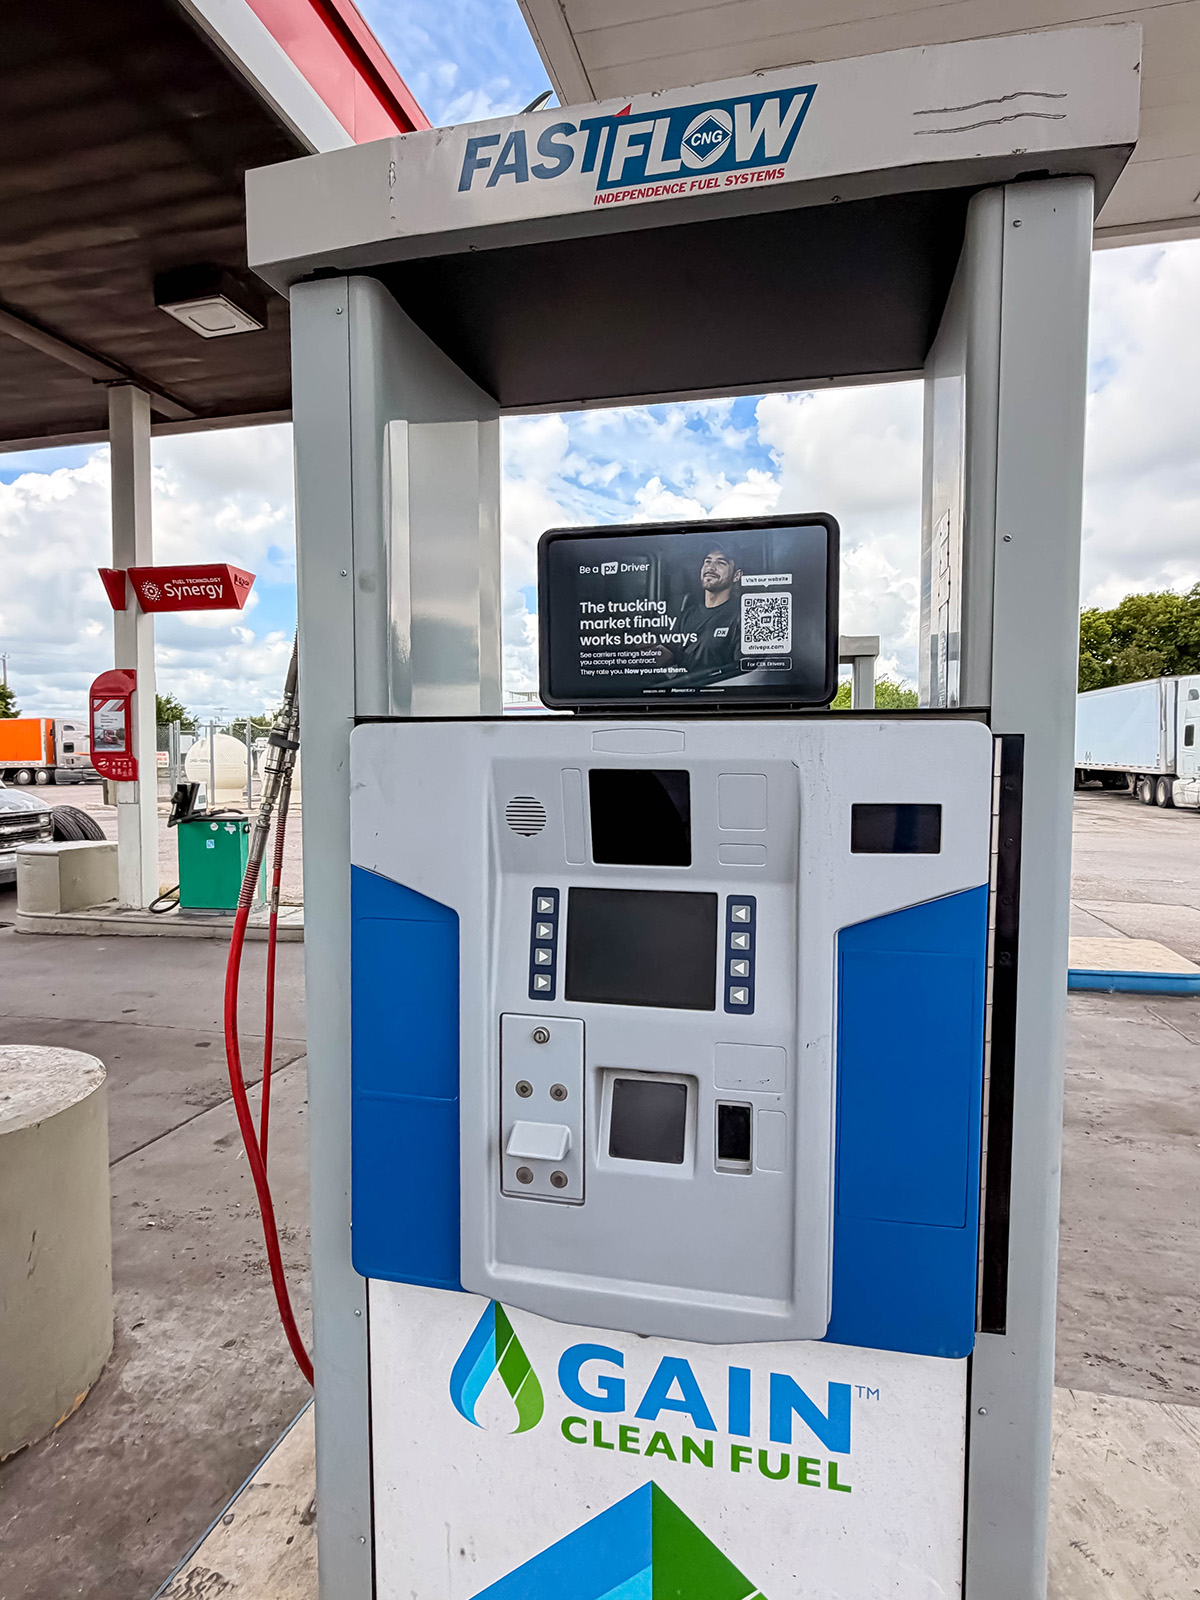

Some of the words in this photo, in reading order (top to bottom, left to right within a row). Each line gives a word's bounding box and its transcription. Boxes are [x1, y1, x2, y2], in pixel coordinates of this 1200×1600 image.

[690, 128, 724, 147] CNG
[593, 181, 687, 205] INDEPENDENCE
[689, 177, 721, 193] FUEL
[724, 167, 786, 187] SYSTEMS
[579, 565, 591, 574] Be
[603, 563, 617, 575] px
[620, 562, 650, 573] Driver
[163, 583, 223, 600] Synergy
[580, 601, 605, 614] The
[608, 599, 667, 614] trucking
[580, 617, 631, 630] market
[633, 615, 677, 631] finally
[580, 633, 621, 646] works
[624, 632, 657, 645] both
[660, 632, 698, 647] ways
[617, 650, 640, 659] ratings
[580, 669, 595, 677] They
[640, 668, 653, 676] you
[557, 1343, 851, 1455] GAIN
[560, 1415, 714, 1468] CLEAN
[731, 1443, 853, 1493] FUEL
